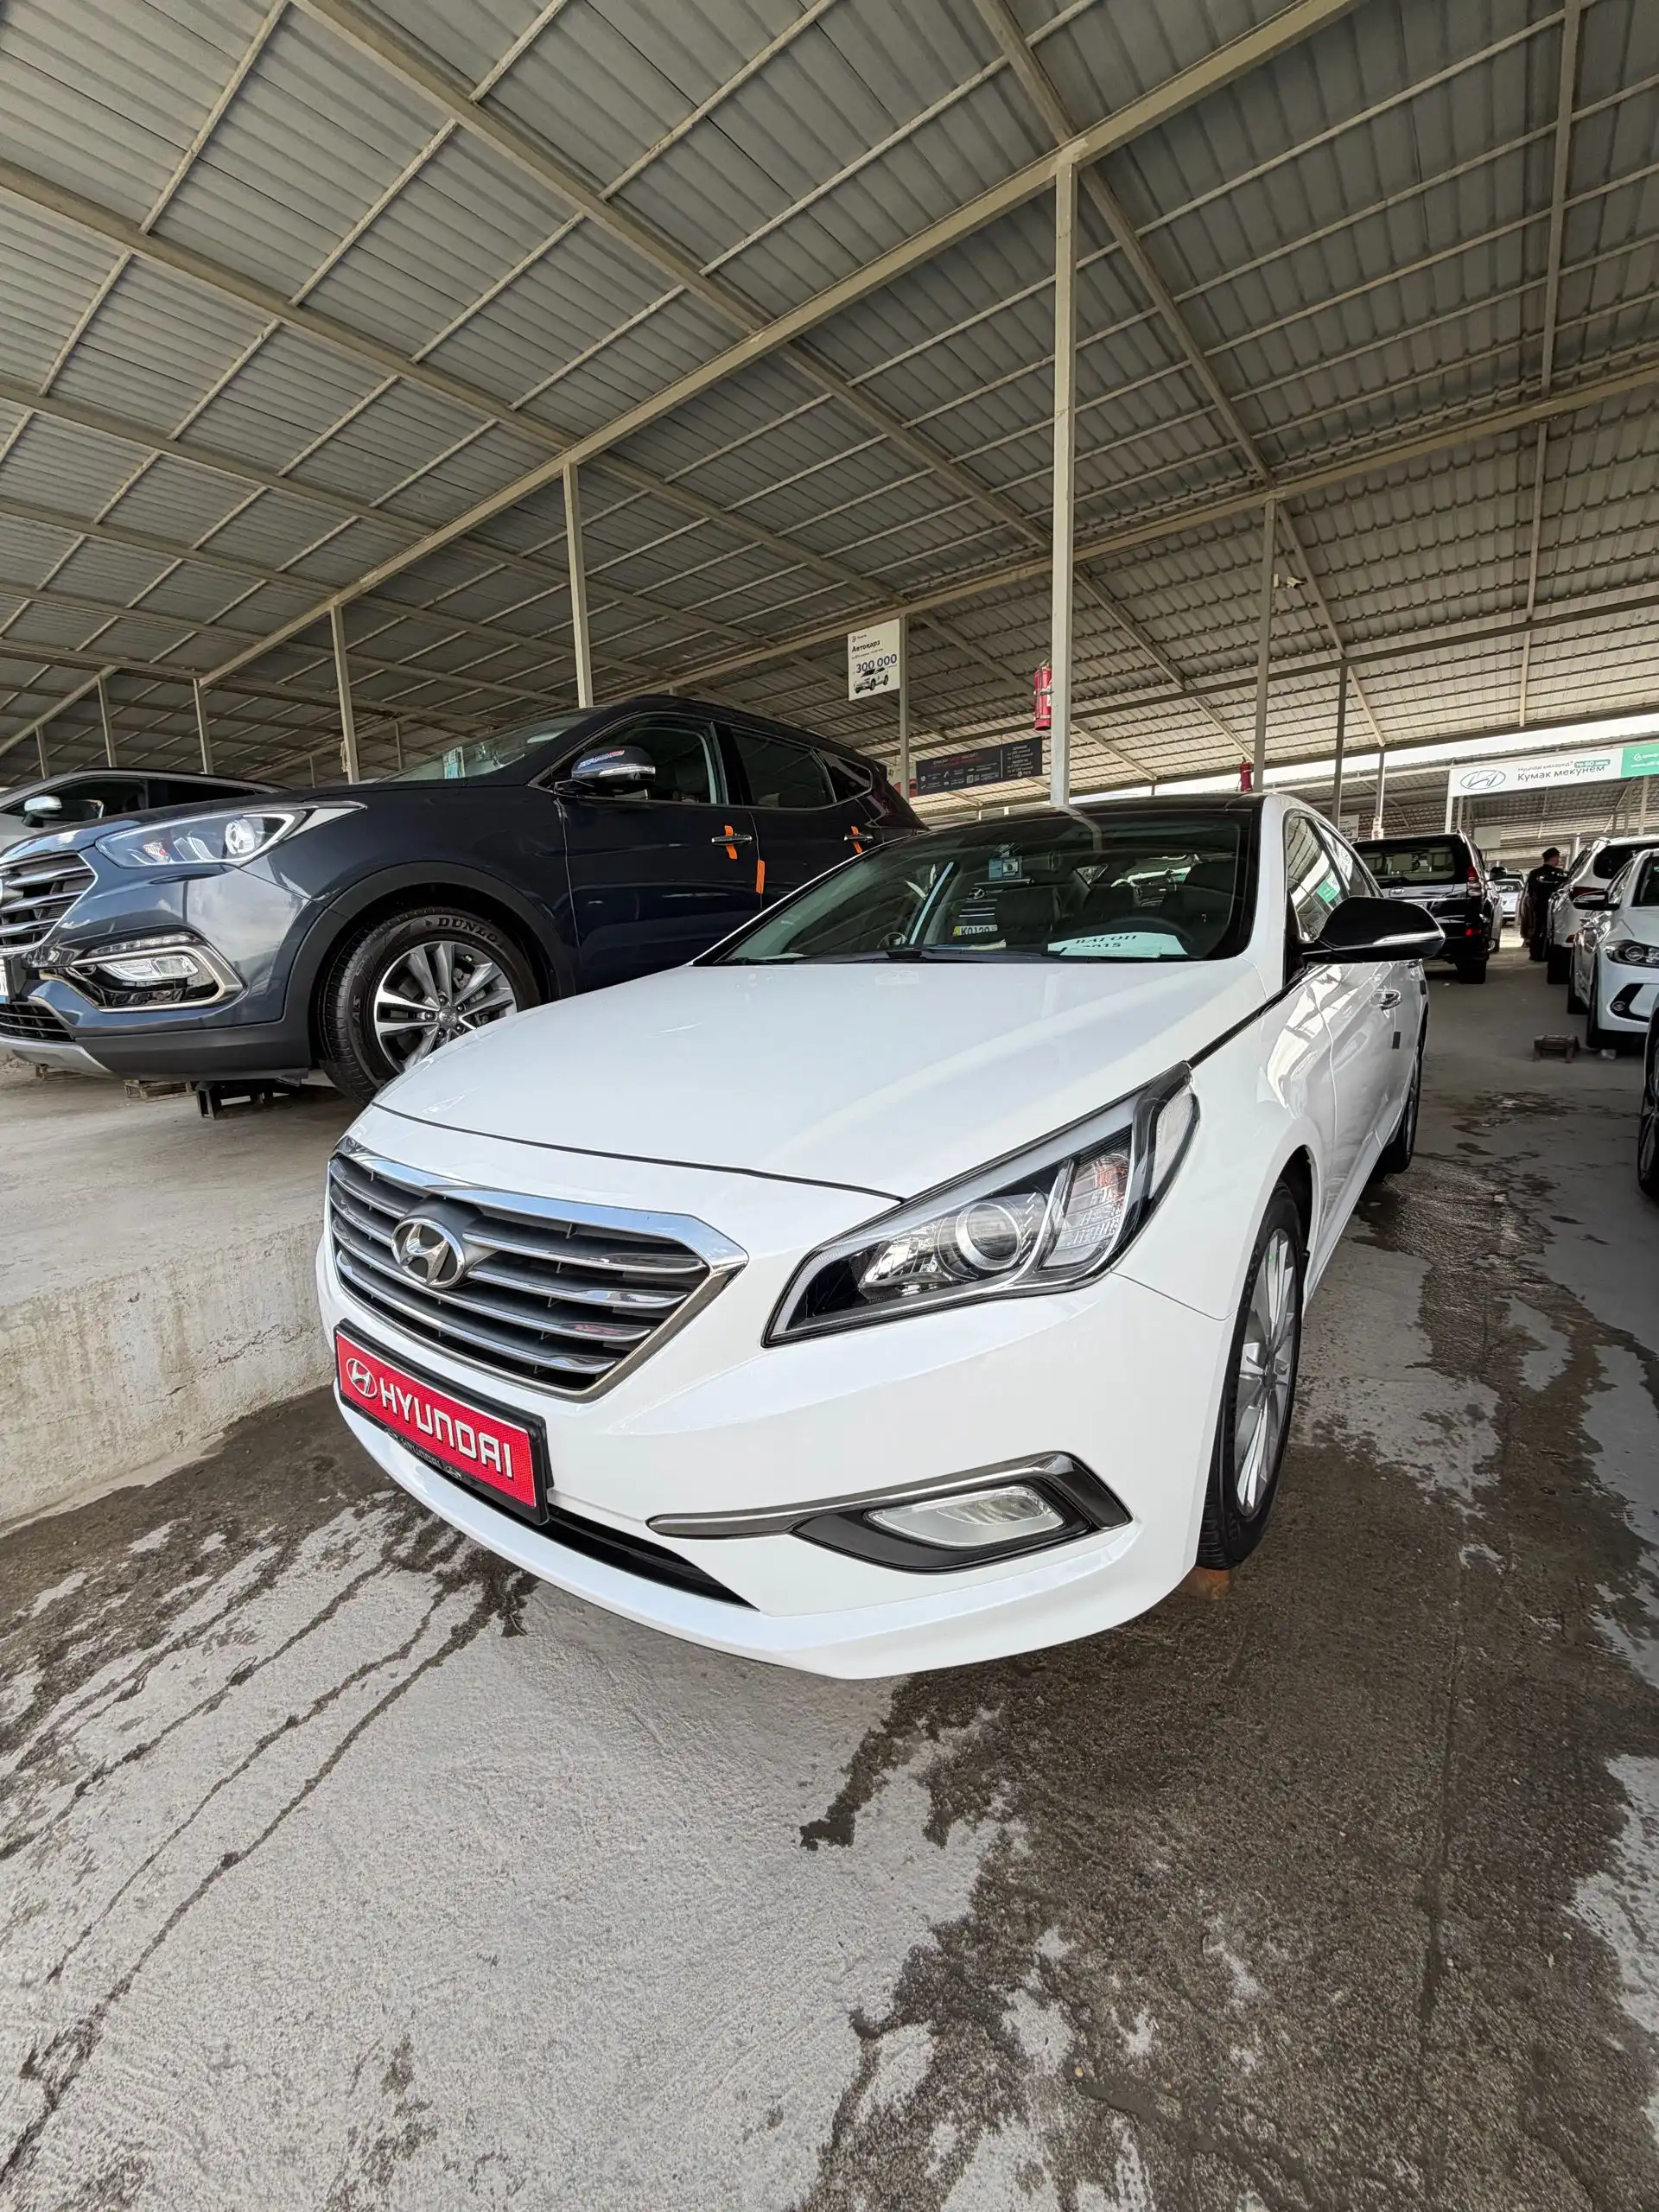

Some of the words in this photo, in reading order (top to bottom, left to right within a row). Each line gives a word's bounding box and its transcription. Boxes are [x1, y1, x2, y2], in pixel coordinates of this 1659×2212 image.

[856, 660, 875, 674] 300
[877, 653, 897, 667] 000
[1517, 772, 1552, 781] Кумак
[1554, 766, 1605, 776] мекунем
[438, 918, 502, 948] DUNLO
[379, 1377, 513, 1478] HYUNDAI
